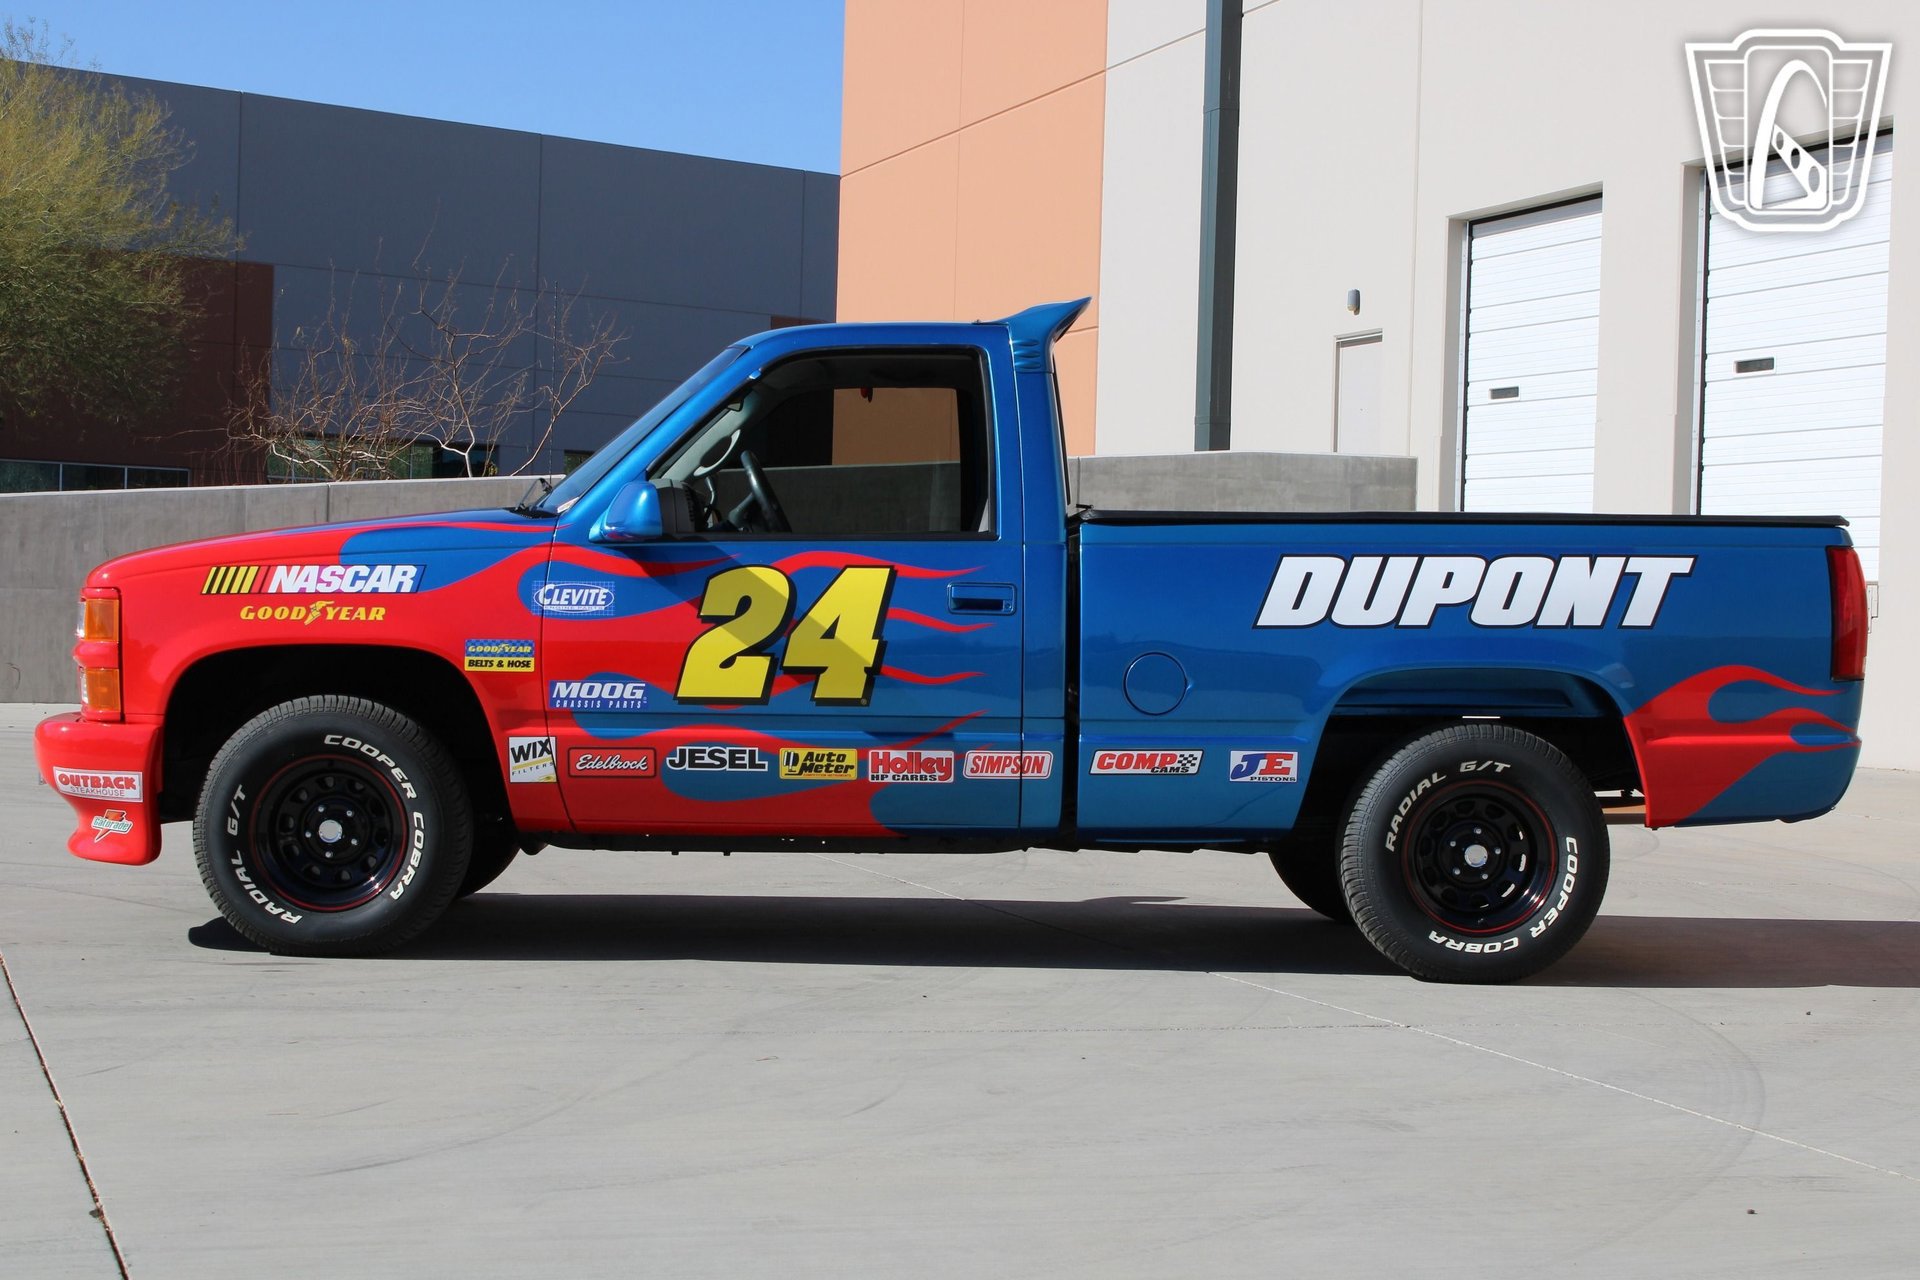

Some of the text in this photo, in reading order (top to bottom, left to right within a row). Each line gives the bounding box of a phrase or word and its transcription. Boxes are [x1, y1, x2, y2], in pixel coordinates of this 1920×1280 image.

[267, 565, 417, 593] NASCAR
[539, 584, 609, 605] CLEVITE
[1252, 554, 1698, 629] DUPONT
[673, 563, 898, 707] 24
[468, 659, 532, 668] BELTS & HOSE
[552, 682, 646, 699] MOOG
[556, 700, 643, 709] CHASSIS PARTS
[510, 738, 553, 764] WIX
[666, 746, 768, 772] JESEL
[803, 752, 847, 763] Auto
[1096, 753, 1179, 770] COMP
[575, 754, 648, 771] Edelbrock
[799, 762, 855, 775] Meter
[871, 751, 952, 781] Holley
[970, 755, 1046, 775] SIMPSON
[1230, 753, 1294, 780] JE
[58, 773, 136, 790] OUTBACK
[892, 774, 938, 782] CARBS
[70, 786, 125, 797] STEAKHOUSE
[1384, 760, 1511, 852] RADIAL G/T
[324, 734, 425, 900] COOPER COBRA
[227, 784, 303, 924] RADIAL G/T
[1428, 836, 1579, 954] COOPER COBRA
